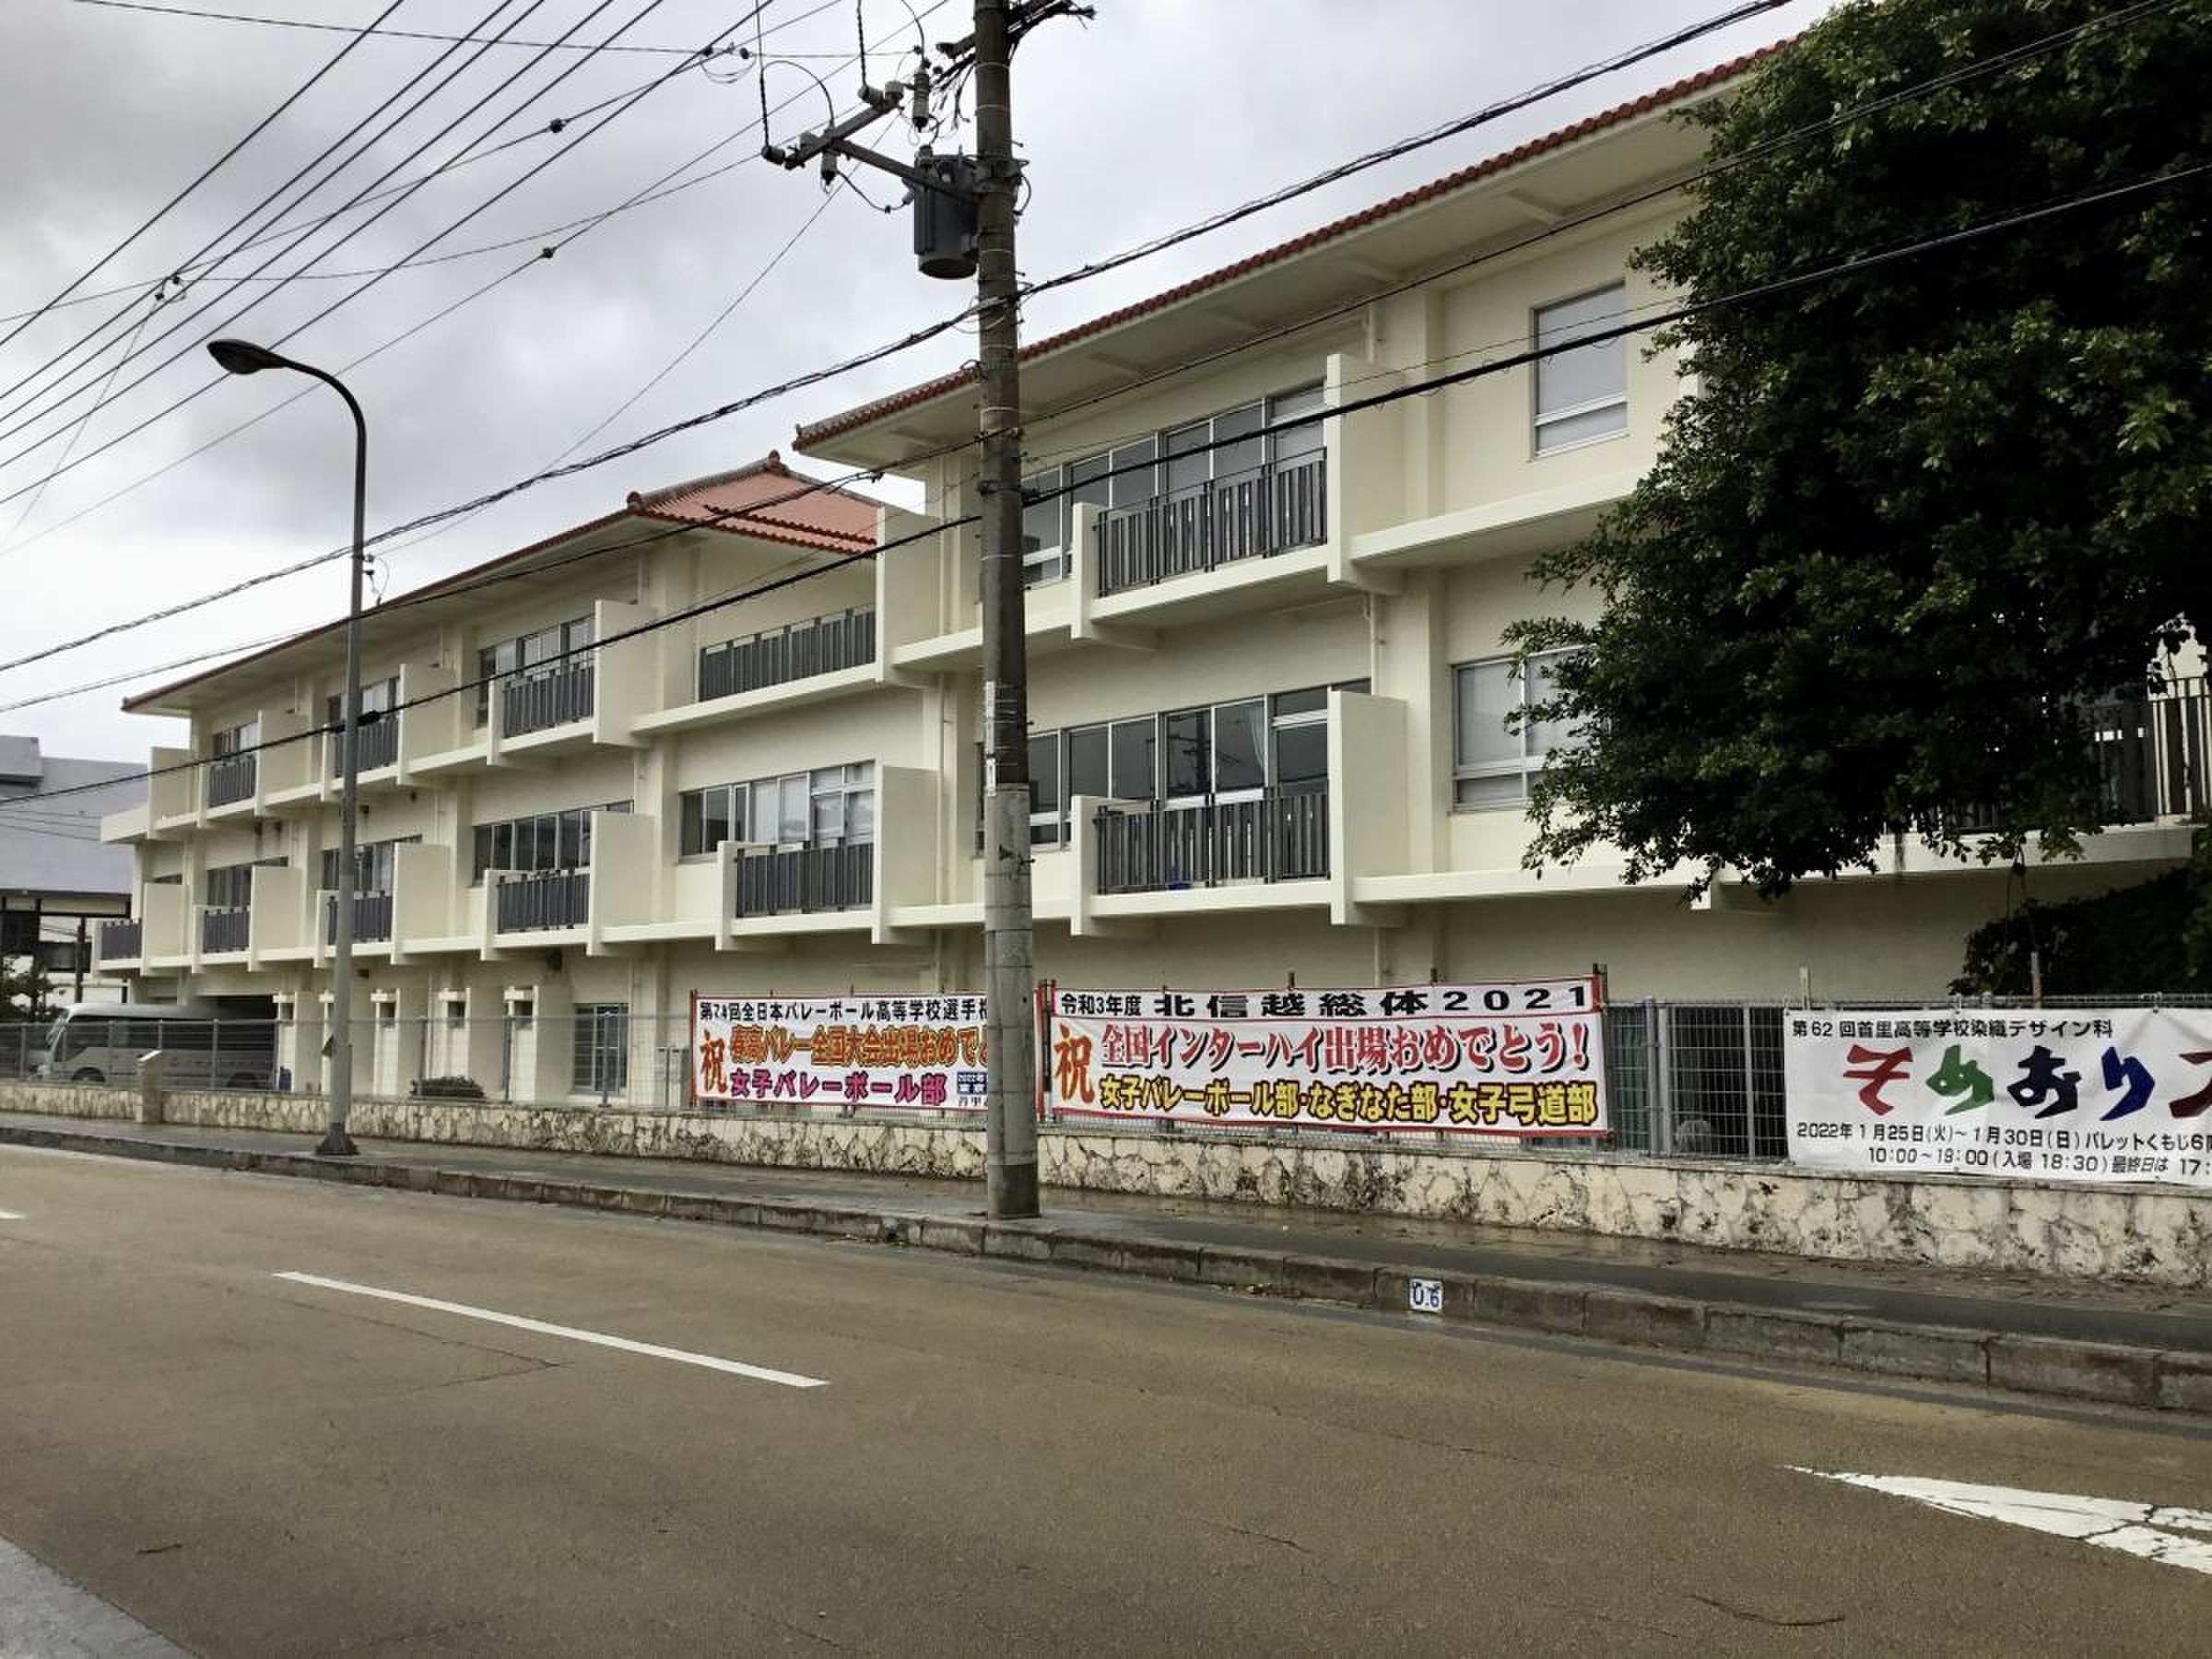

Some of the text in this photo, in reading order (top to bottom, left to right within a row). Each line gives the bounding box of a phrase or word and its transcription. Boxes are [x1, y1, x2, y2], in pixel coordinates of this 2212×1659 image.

[1061, 993, 1142, 1016] 令和3年度
[700, 1029, 727, 1093] 祝
[1053, 1023, 1095, 1103] 祝
[1101, 1022, 1589, 1076] 全国インターハイ出場おめでとう!
[730, 1068, 947, 1105] 女子バレーボール部
